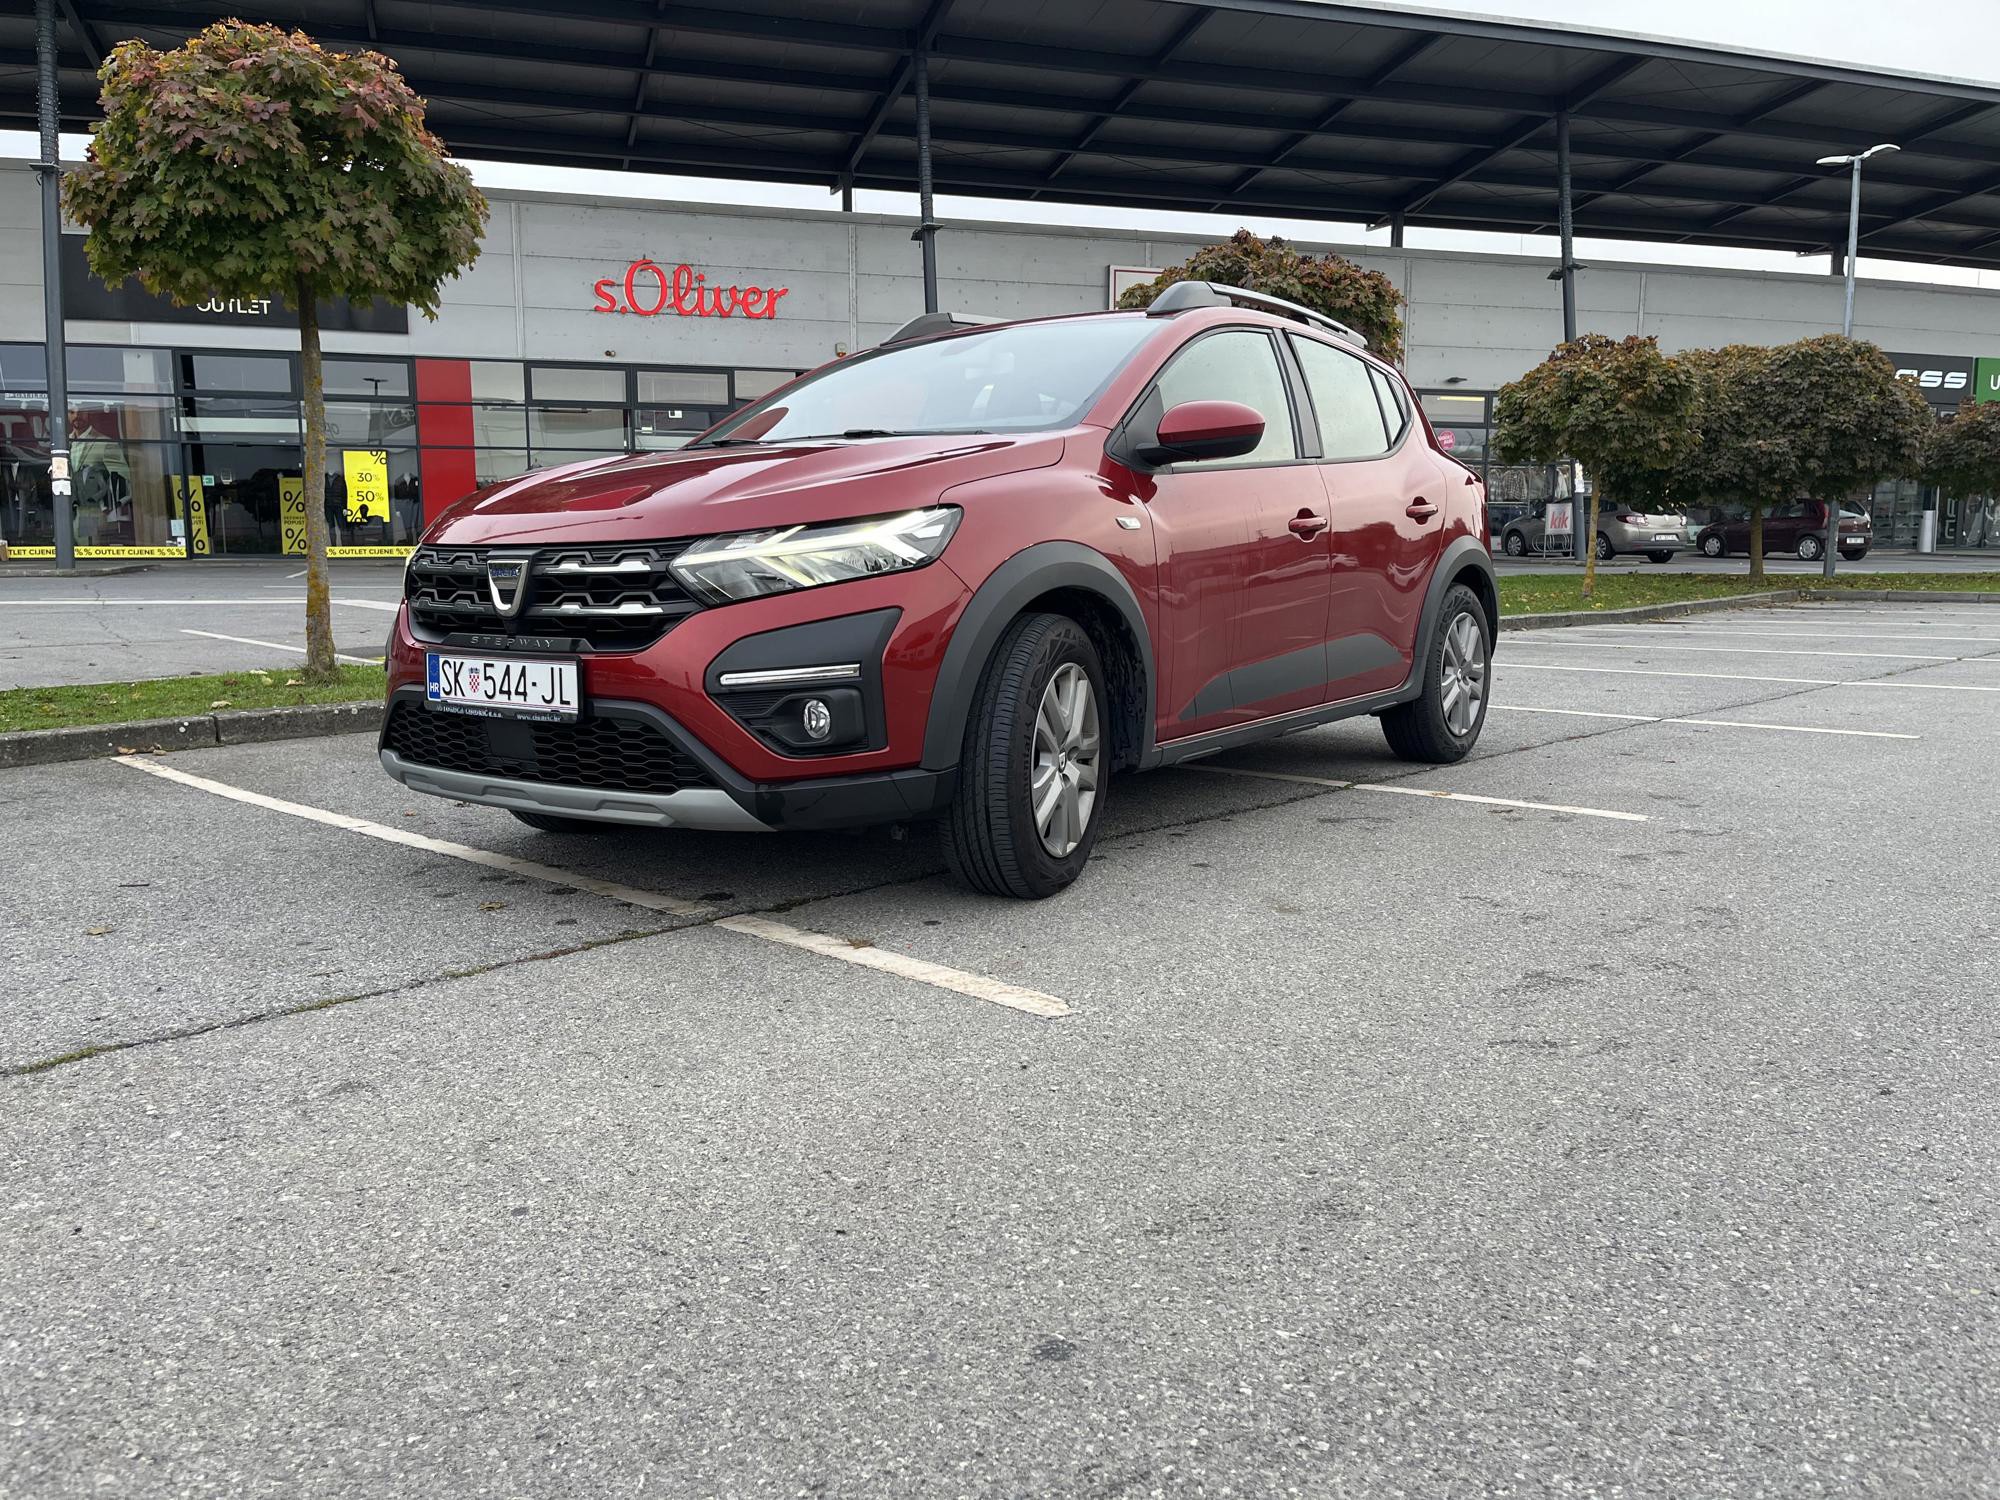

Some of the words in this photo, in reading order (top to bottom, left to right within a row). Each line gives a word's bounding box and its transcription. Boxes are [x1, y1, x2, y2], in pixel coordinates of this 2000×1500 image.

[594, 259, 789, 320] s.Oliver
[1550, 511, 1569, 529] kik
[470, 636, 554, 648] STEPWAY
[429, 682, 440, 693] HR
[441, 659, 466, 698] SK
